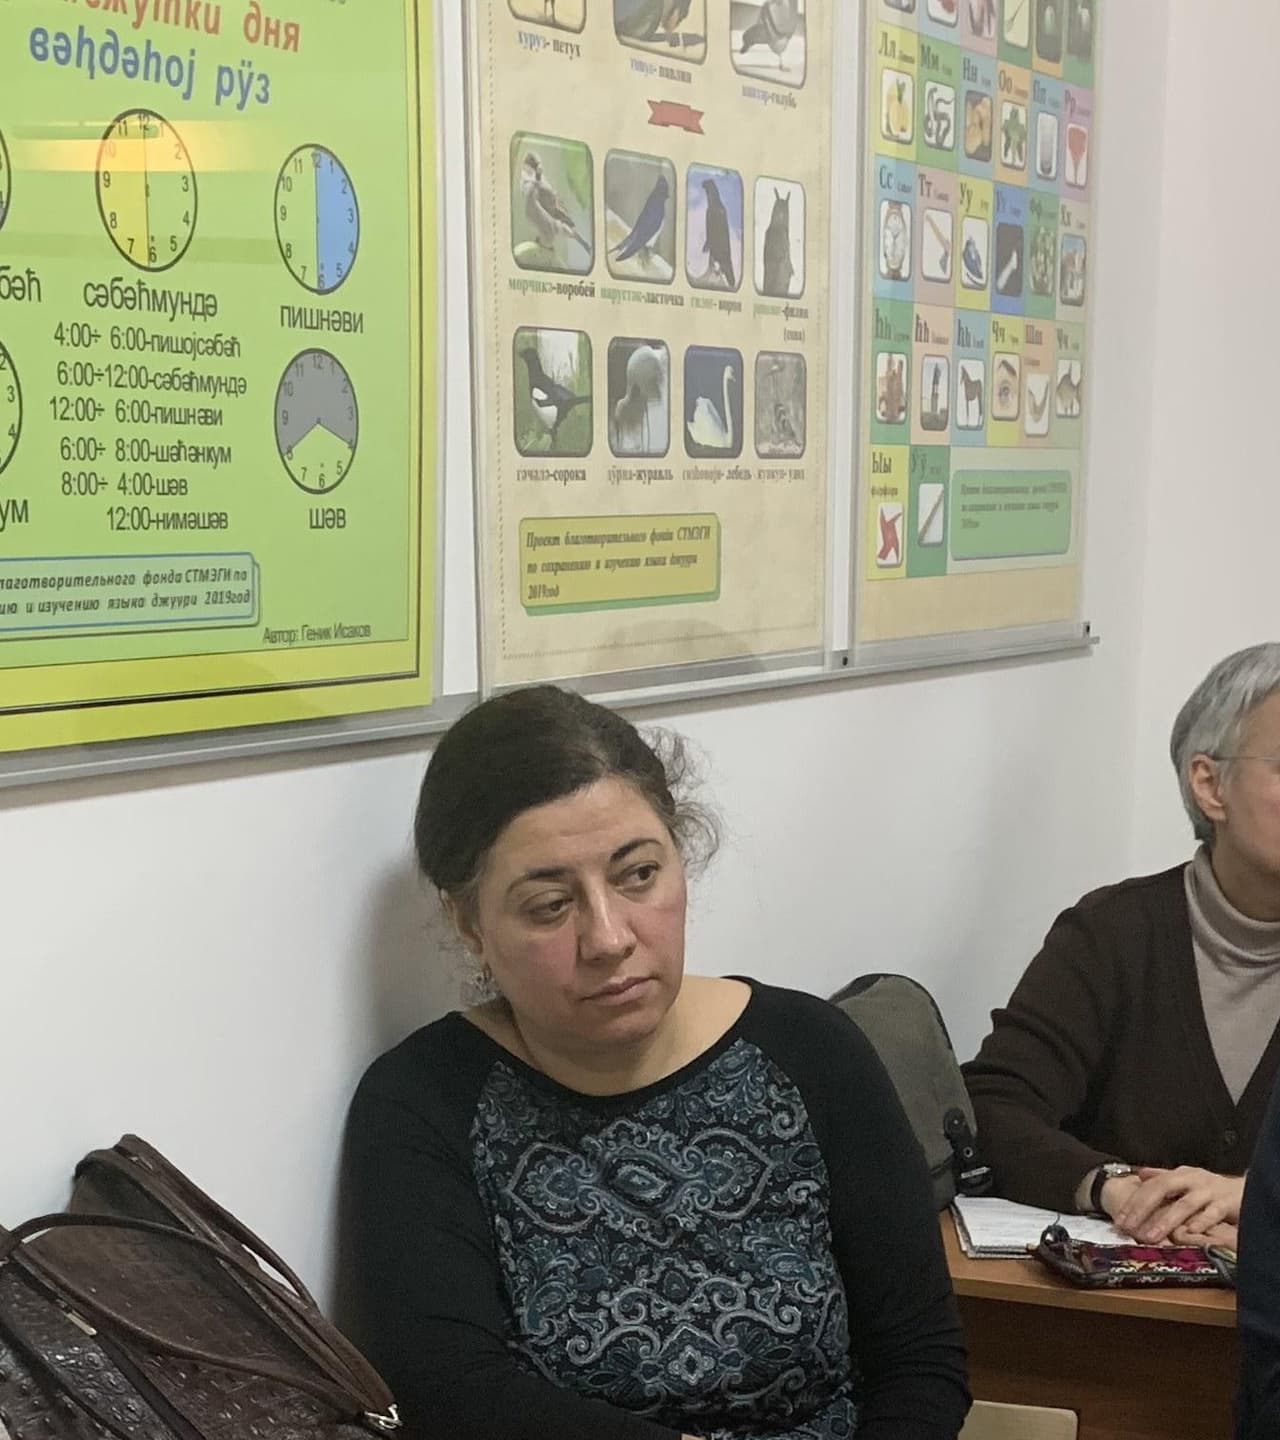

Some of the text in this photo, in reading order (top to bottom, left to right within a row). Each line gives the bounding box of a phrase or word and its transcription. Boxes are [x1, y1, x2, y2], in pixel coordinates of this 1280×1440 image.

[243, 1, 301, 52] дня
[118, 120, 128, 138] 11
[174, 142, 182, 161] 2
[294, 157, 303, 175] 11
[103, 171, 111, 189] 9
[182, 175, 189, 193] 3
[281, 175, 292, 193] 10
[341, 178, 348, 195] 2
[109, 212, 118, 230] 8
[182, 211, 190, 227] 4
[280, 204, 287, 222] 9
[347, 207, 354, 224] 3
[127, 238, 135, 255] 7
[170, 235, 178, 252] 5
[285, 243, 292, 260] 8
[149, 246, 157, 264] 6
[300, 265, 307, 281] 7
[336, 262, 343, 279] 5
[318, 273, 325, 290] 6
[280, 304, 364, 335] пишнәви
[312, 354, 324, 371] 12
[7, 384, 15, 404] 3
[341, 377, 348, 394] 2
[282, 409, 289, 427] 9
[347, 405, 354, 422] 3
[8, 423, 16, 441] 4
[301, 466, 307, 482] 7
[336, 460, 343, 476] 5
[318, 472, 325, 489] 6
[309, 507, 347, 530] шәв
[526, 532, 561, 551] Проект
[142, 569, 182, 592] фонда
[184, 568, 232, 584] СТМЭГИ
[233, 570, 248, 583] по
[25, 600, 34, 614] и
[38, 597, 100, 616] изучению
[107, 595, 146, 610] языка
[151, 592, 198, 611] джуури
[204, 589, 251, 607] 2019год
